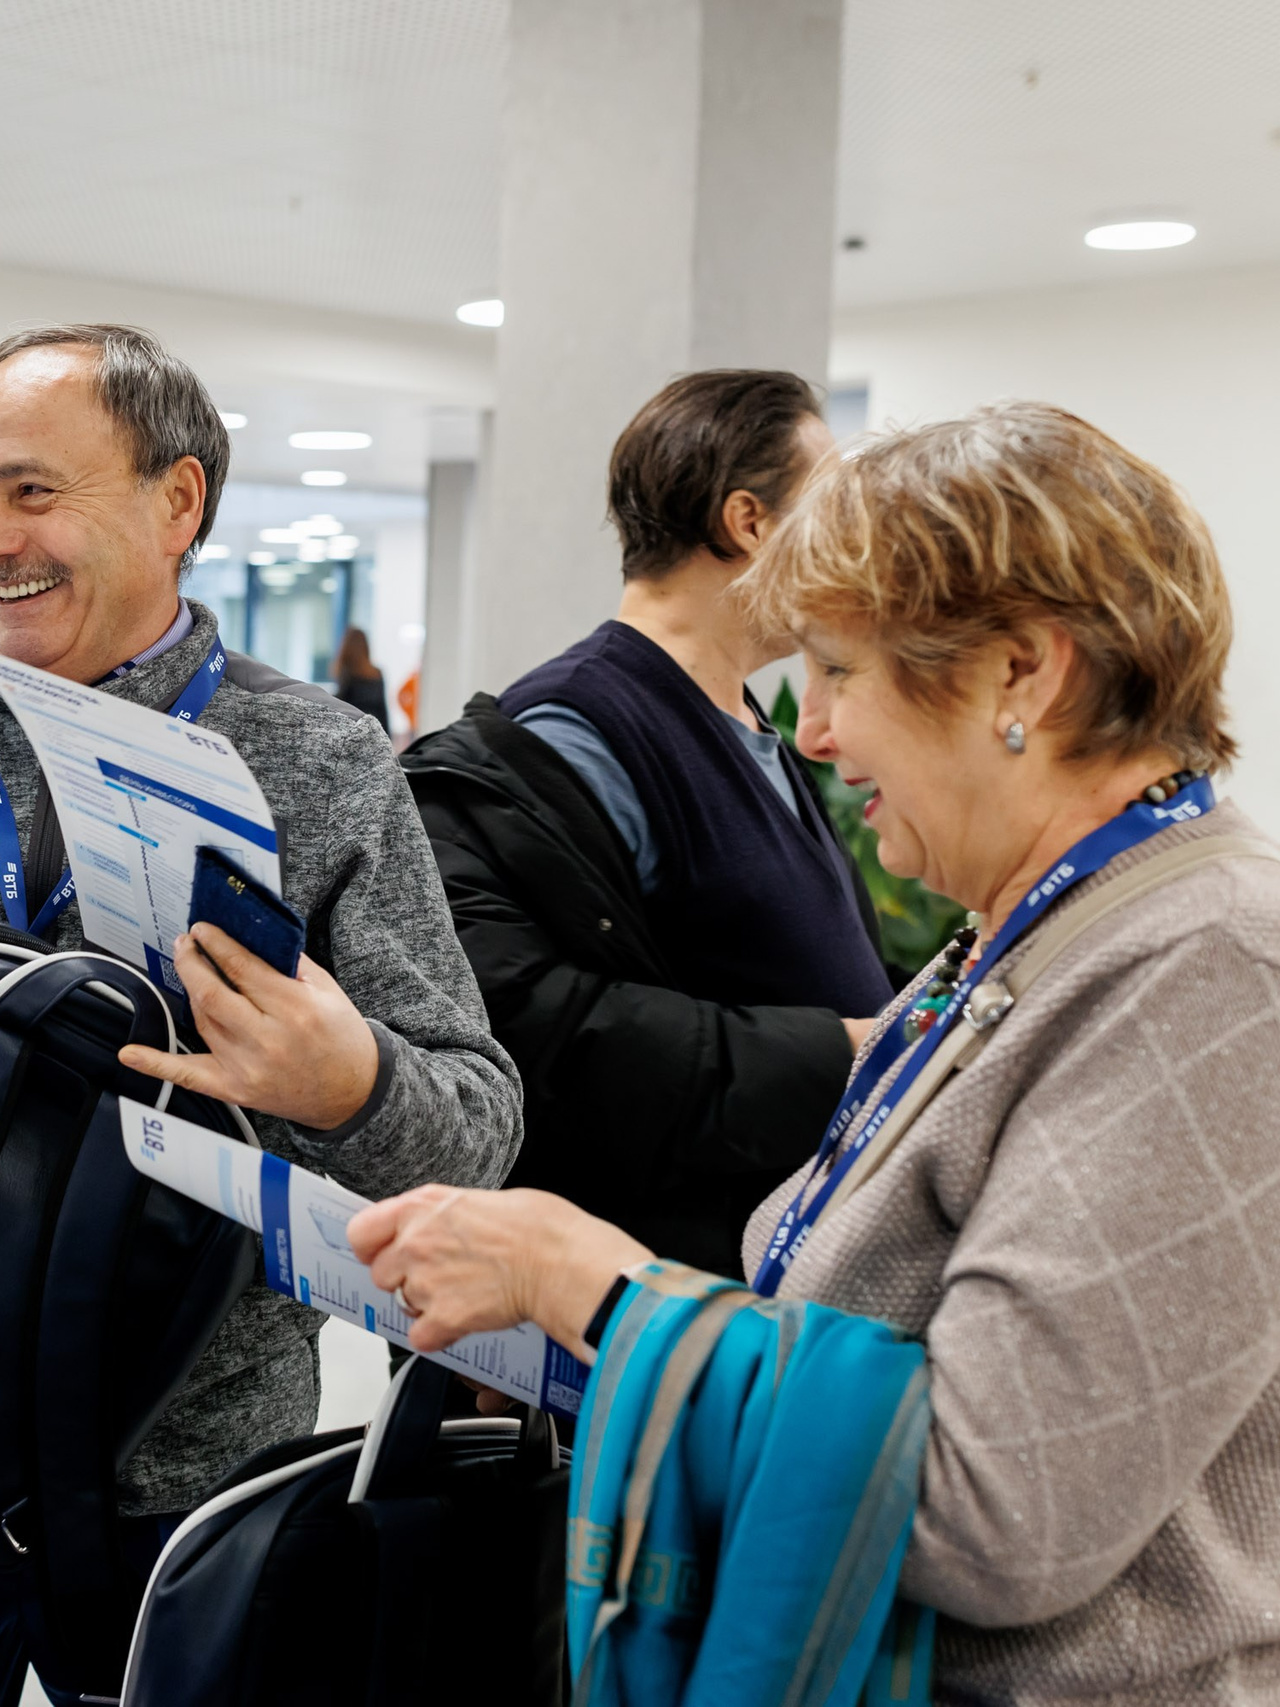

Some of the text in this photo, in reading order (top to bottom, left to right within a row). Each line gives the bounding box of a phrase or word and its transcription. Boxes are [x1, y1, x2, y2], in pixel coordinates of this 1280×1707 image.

[214, 652, 225, 672] ВТБ
[176, 710, 192, 723] ТБ
[185, 731, 229, 756] ВТБ
[3, 874, 18, 899] ВТБ
[60, 877, 76, 898] ВТ
[1039, 862, 1075, 896] ВТБ
[864, 1104, 891, 1138] ВТБ
[142, 1116, 165, 1152] ВТБ
